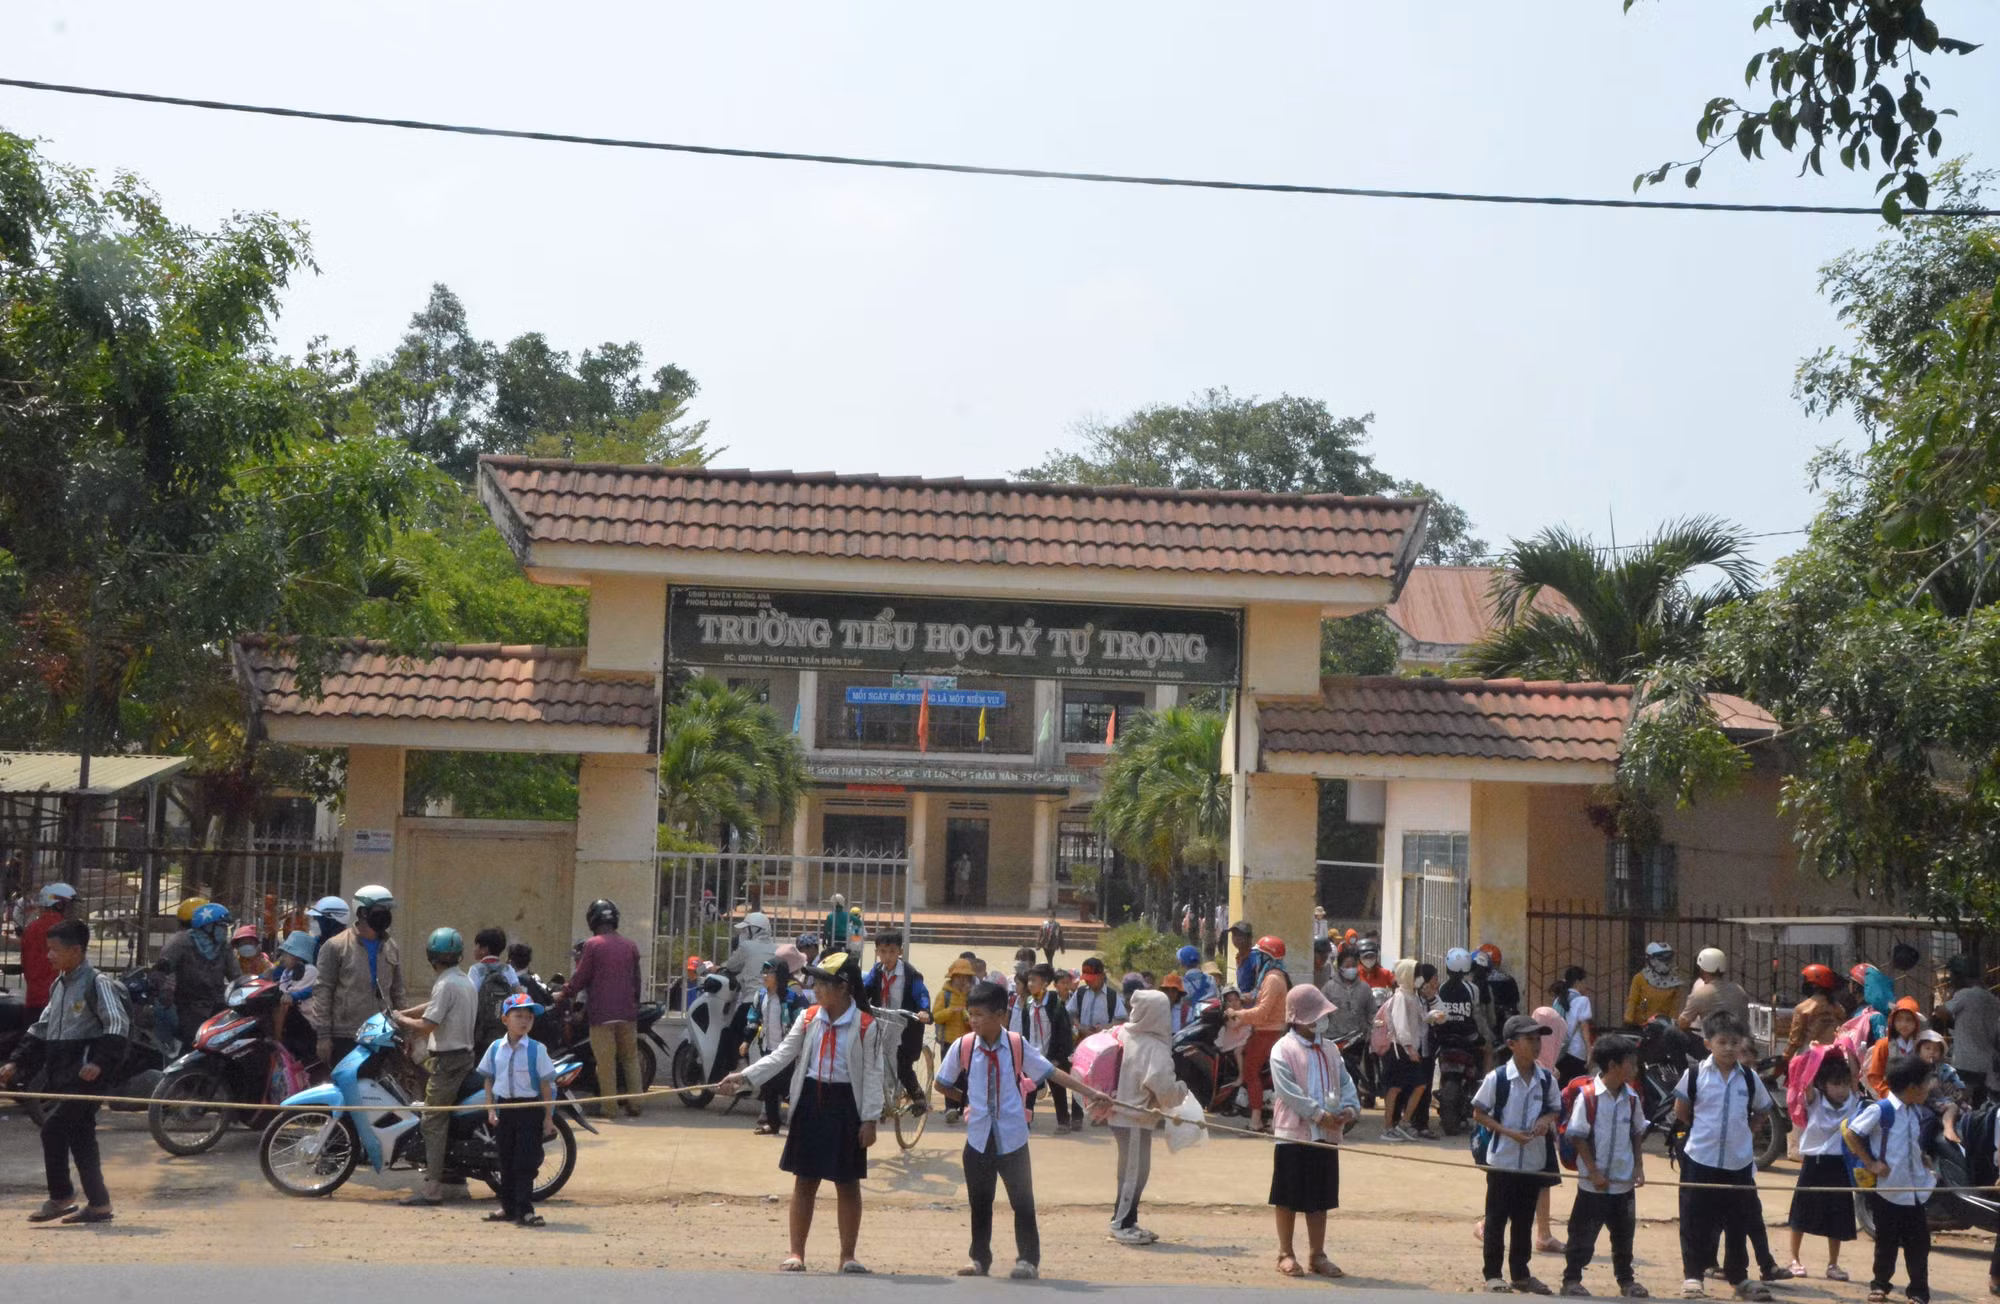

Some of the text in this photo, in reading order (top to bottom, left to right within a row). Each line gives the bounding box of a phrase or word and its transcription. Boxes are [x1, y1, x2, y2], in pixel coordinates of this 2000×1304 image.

[698, 607, 1208, 668] TRƯỜNG TIỂU HỌC LÝ TỰ TRỌNG
[868, 691, 888, 701] NGÀY
[889, 690, 905, 701] ĐẾN
[906, 692, 936, 703] TRƯNG
[937, 693, 947, 703] LÀ
[949, 693, 965, 704] MỘT
[987, 695, 1000, 704] VUI
